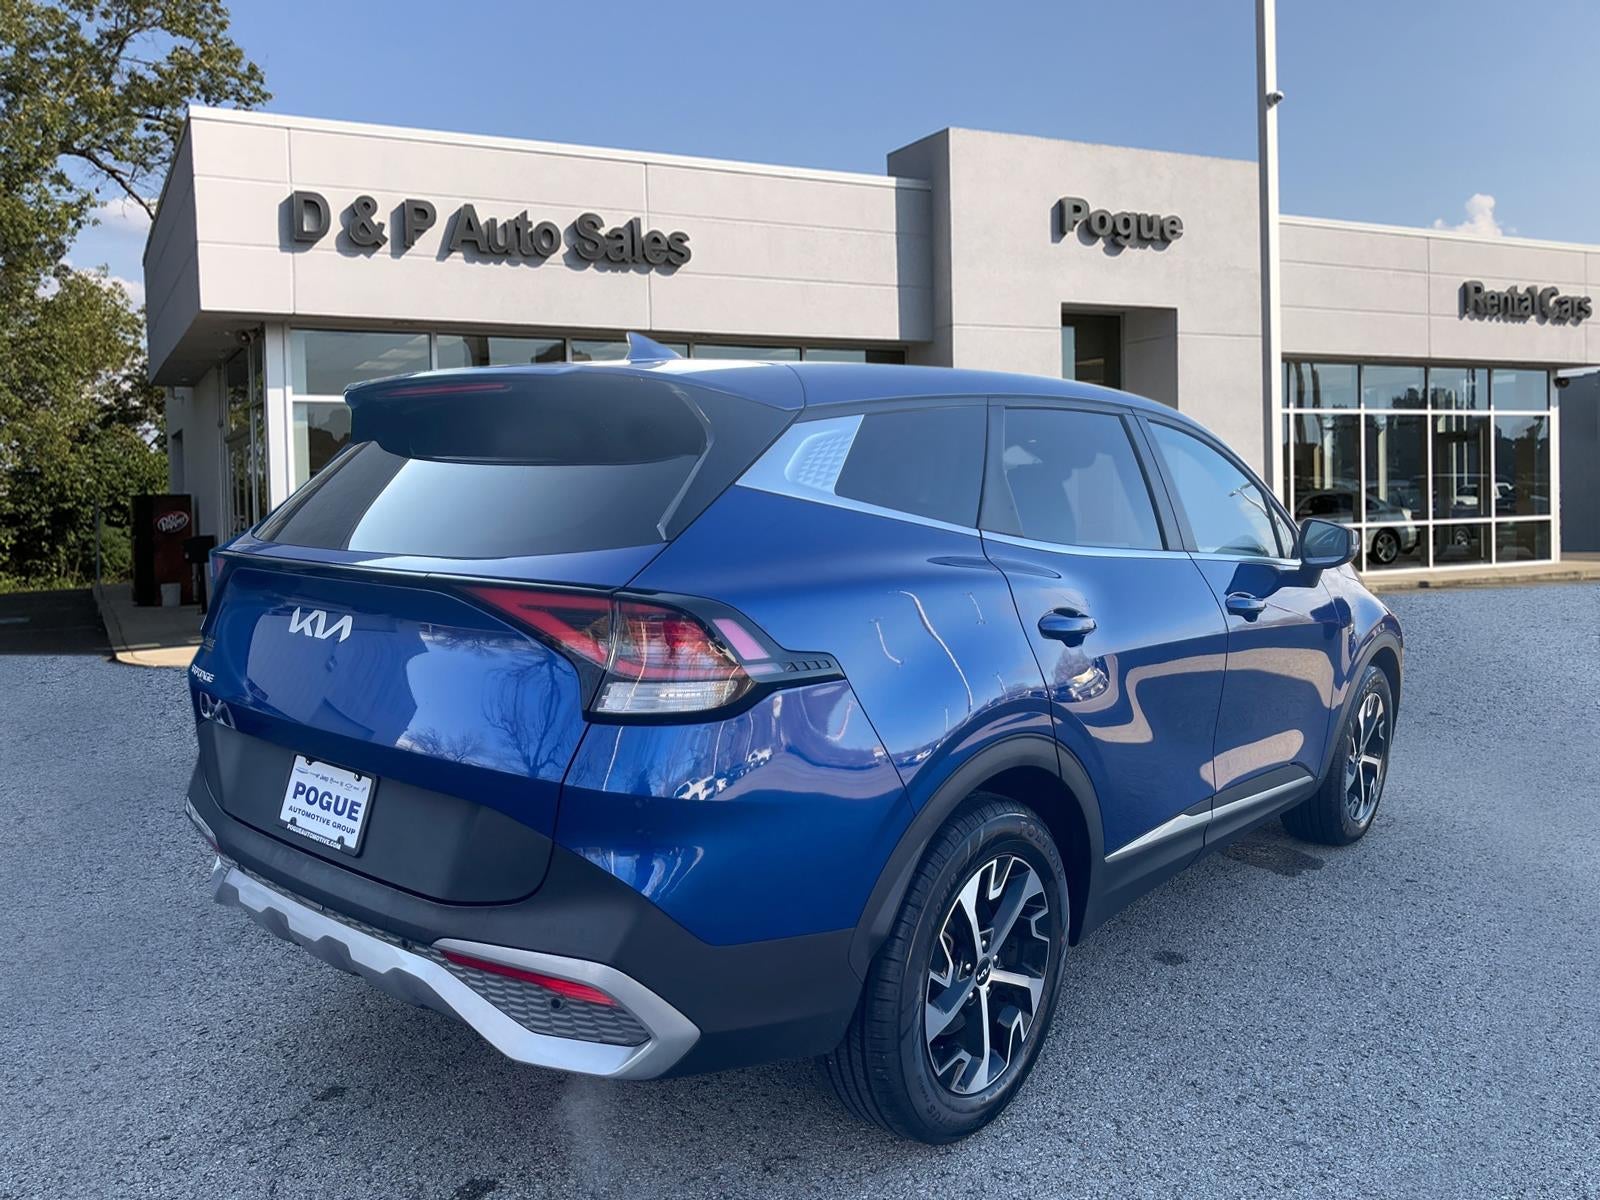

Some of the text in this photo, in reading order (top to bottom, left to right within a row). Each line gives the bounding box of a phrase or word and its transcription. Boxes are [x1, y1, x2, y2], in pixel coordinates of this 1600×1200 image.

[290, 190, 692, 266] D & P Auto Sales
[1060, 196, 1184, 247] Pogue
[1463, 280, 1592, 320] Rental Cars
[288, 606, 353, 643] KIA
[288, 805, 356, 835] AUTOMOTIVE GROUP
[292, 780, 362, 822] POGUE
